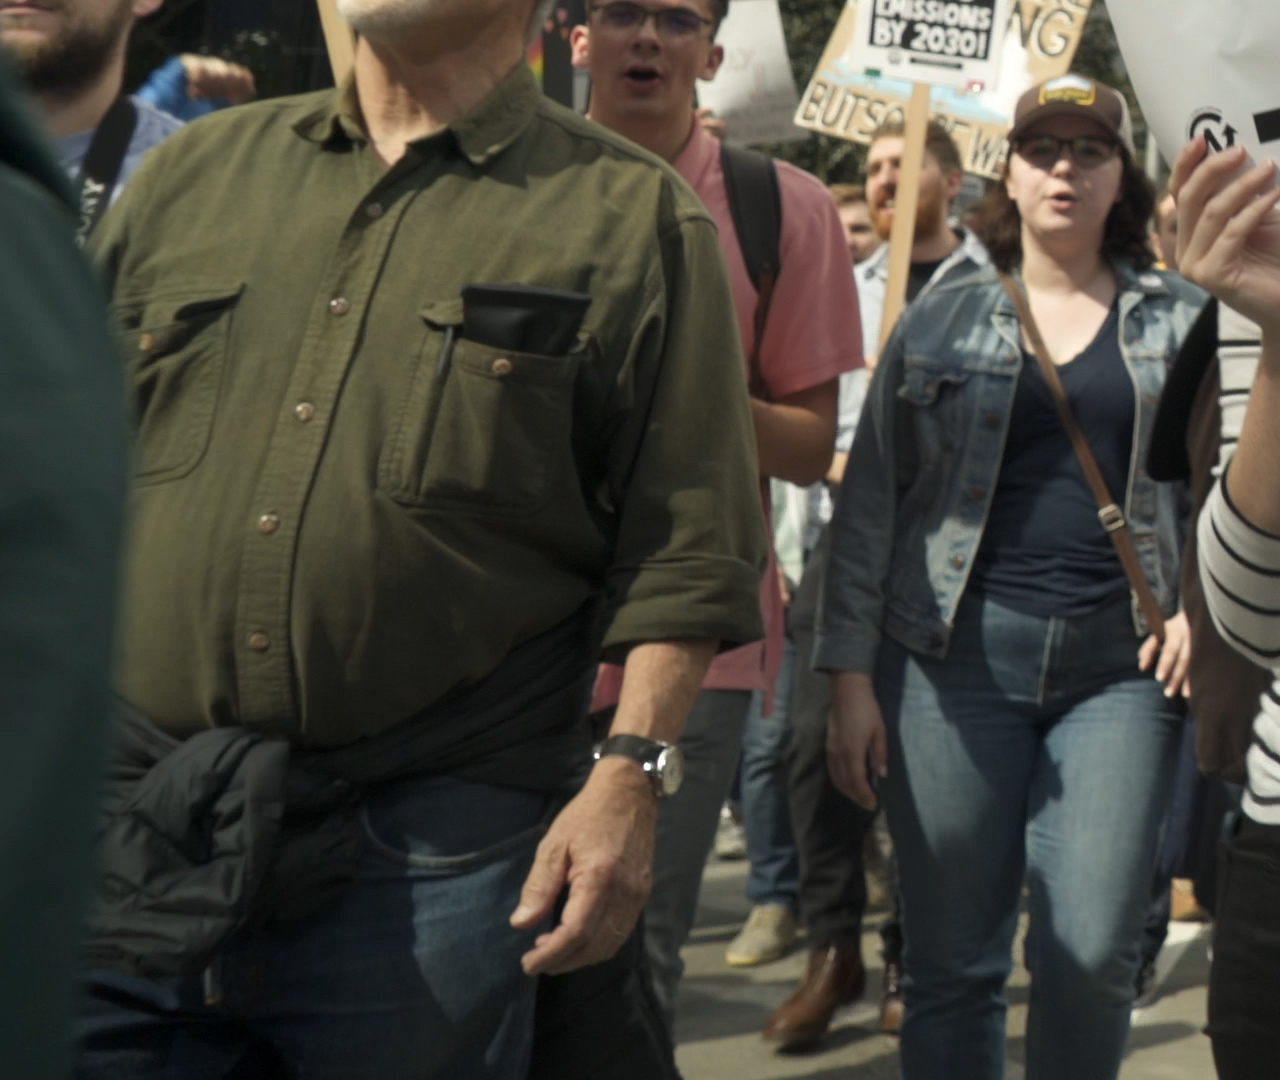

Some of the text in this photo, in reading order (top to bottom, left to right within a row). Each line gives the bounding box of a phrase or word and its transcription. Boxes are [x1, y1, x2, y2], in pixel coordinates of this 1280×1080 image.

[872, 17, 908, 46] BY
[910, 21, 988, 59] 2030!
[797, 80, 868, 136] BUT
